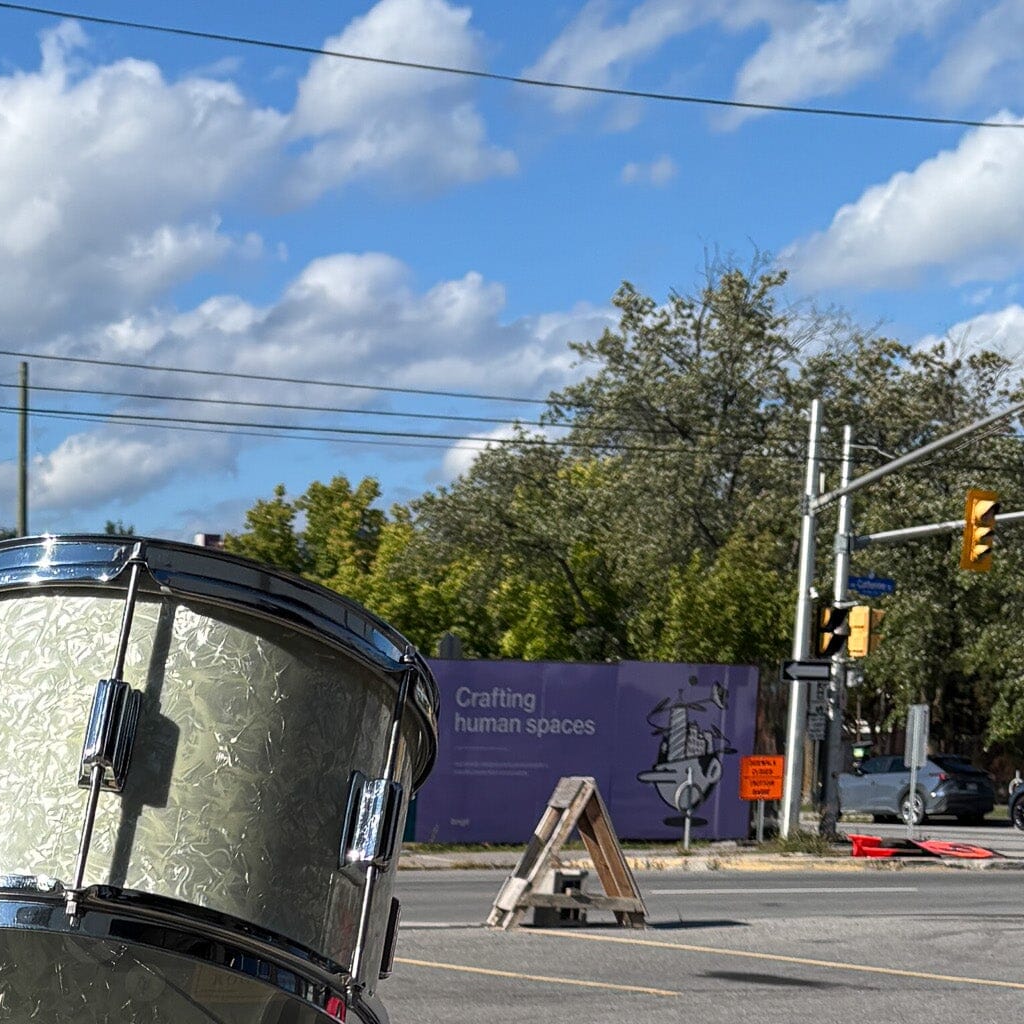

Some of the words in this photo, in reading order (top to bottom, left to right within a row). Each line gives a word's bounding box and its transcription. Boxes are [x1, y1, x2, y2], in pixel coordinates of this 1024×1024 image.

[455, 686, 537, 713] Crafting
[454, 711, 522, 734] human
[525, 718, 596, 738] spaces
